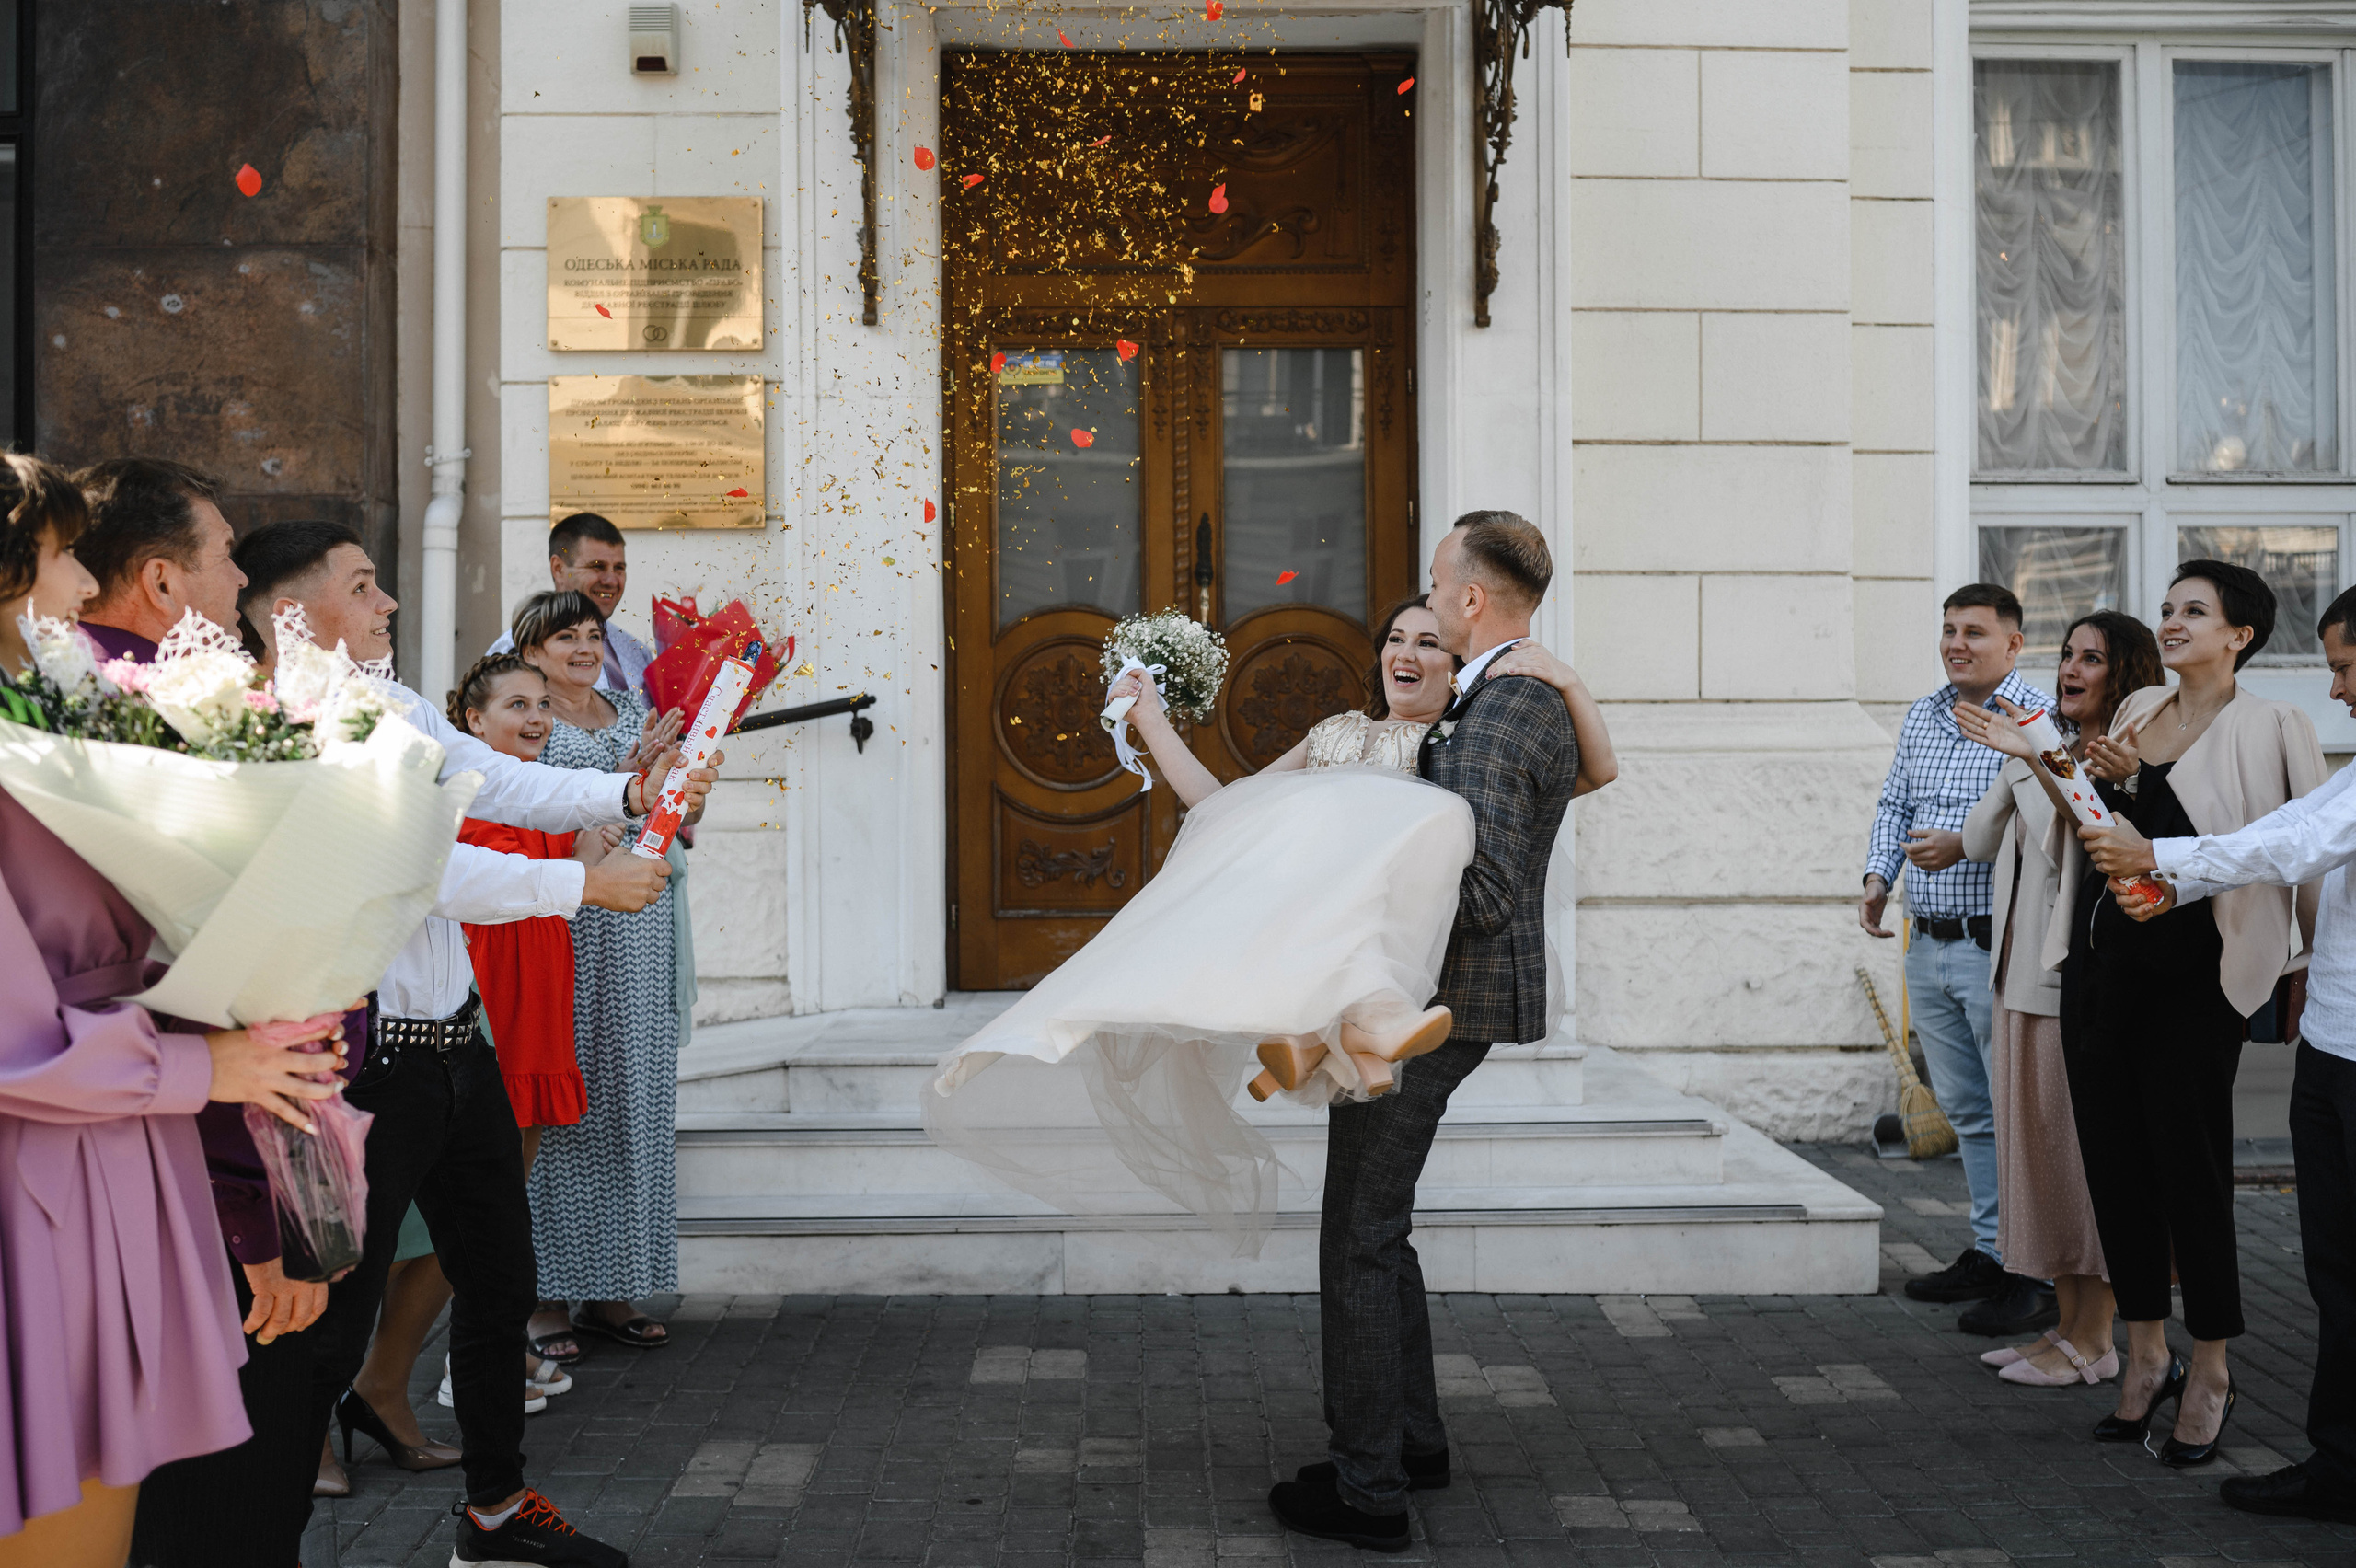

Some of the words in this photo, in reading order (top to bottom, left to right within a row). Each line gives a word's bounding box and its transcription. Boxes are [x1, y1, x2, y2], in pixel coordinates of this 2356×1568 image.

[564, 258, 636, 271] ОДЕСЬКА
[639, 258, 699, 271] МІСЬКА
[702, 258, 742, 271] РАДА
[563, 279, 629, 287] КОМУНАЛЬНЕ
